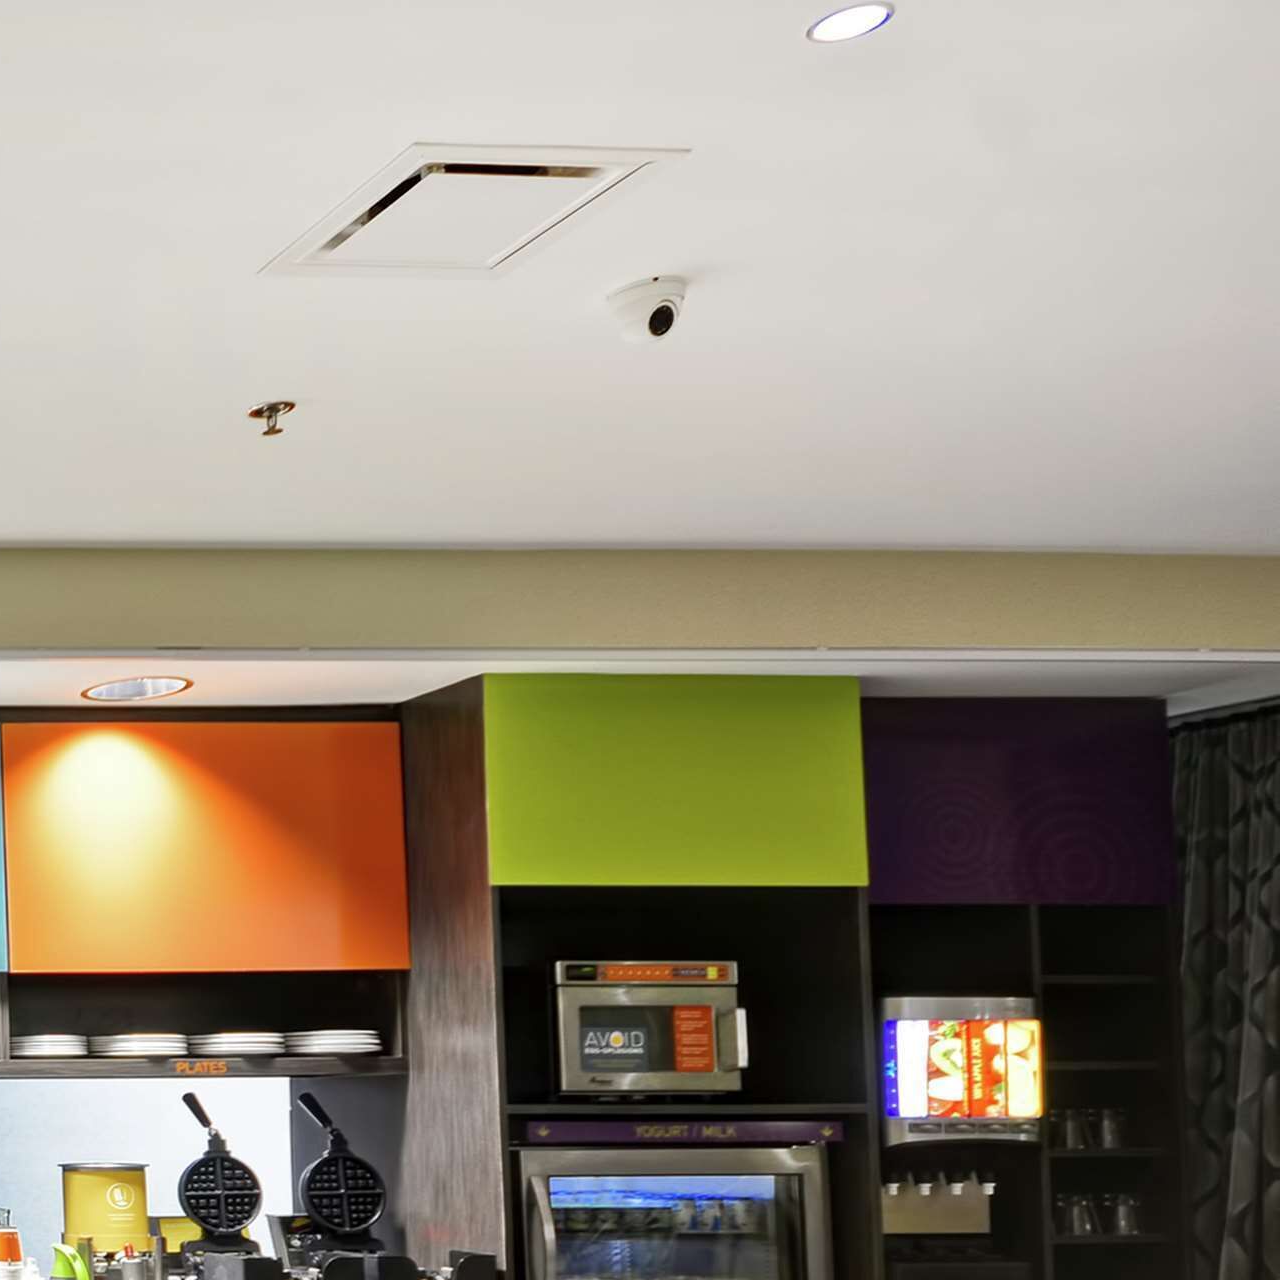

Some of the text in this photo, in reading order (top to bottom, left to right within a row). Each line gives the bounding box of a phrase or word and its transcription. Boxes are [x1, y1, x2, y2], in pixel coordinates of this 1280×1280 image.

[584, 1031, 645, 1047] AVOID
[176, 1060, 226, 1074] PLATES
[635, 1125, 689, 1138] YOGURT
[703, 1125, 737, 1138] MILK
